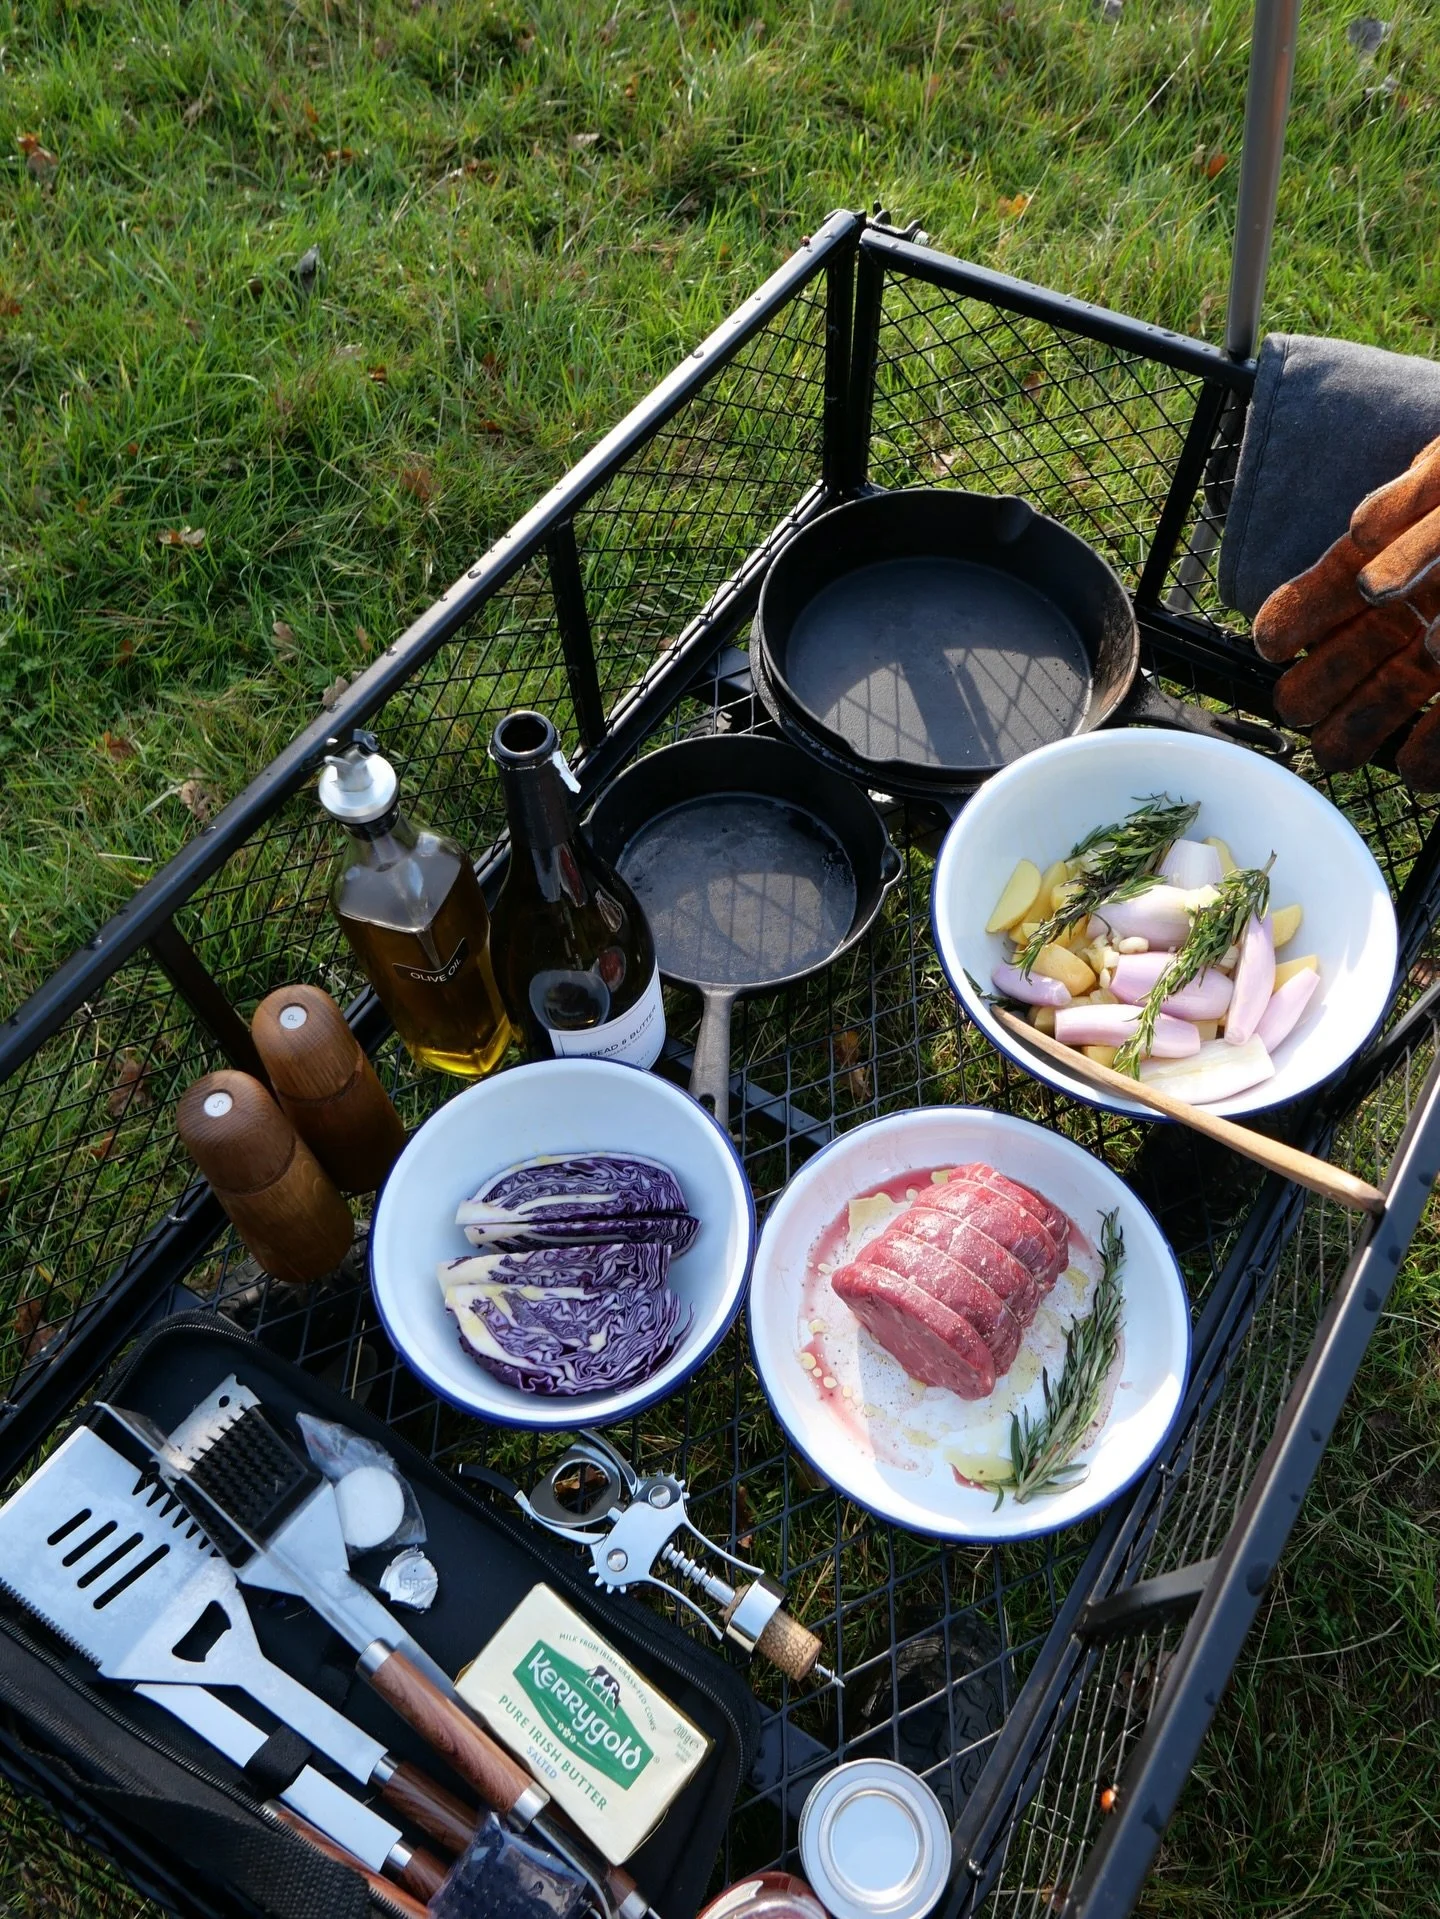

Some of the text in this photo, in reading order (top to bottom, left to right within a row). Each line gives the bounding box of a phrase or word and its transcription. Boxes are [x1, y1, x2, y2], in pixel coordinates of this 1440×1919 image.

[410, 959, 461, 982] OLIVE OIL
[630, 1004, 656, 1040] BUTTER
[559, 1632, 578, 1643] MILK
[580, 1638, 599, 1652] FROM
[600, 1650, 618, 1668] IRISH
[645, 1706, 657, 1732] COWS
[498, 1694, 608, 1811] PURE IRISH BUTTER
[526, 1746, 558, 1780] SALTED
